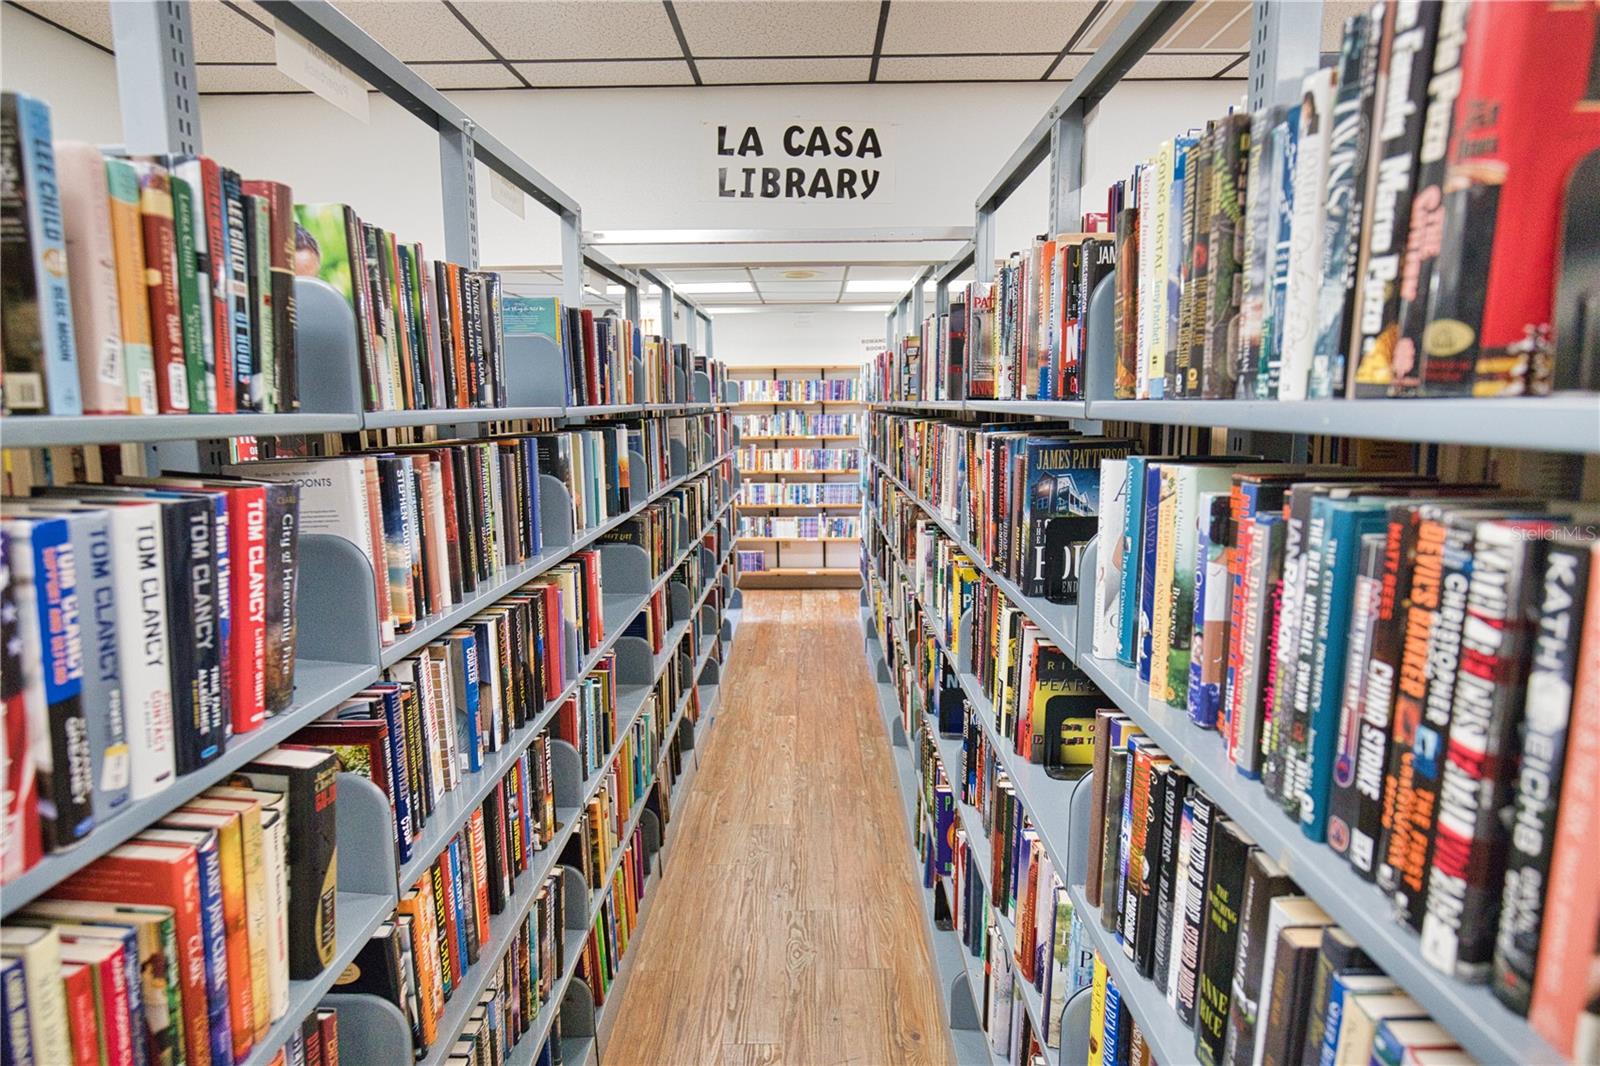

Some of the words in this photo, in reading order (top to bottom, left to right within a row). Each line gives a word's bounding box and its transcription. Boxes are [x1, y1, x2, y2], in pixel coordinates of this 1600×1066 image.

[33, 139, 56, 177] LEE
[717, 126, 764, 157] LA
[783, 125, 882, 158] CASA
[718, 167, 880, 200] LIBRARY
[1156, 151, 1168, 205] GOING
[1182, 155, 1199, 244] BRIMSTONE
[39, 180, 62, 242] CHILD
[227, 199, 243, 228] LEE
[230, 229, 246, 273] CHILD
[1153, 212, 1165, 272] POSTAL
[1361, 255, 1400, 336] Puzo
[1150, 304, 1163, 346] Pratchett
[1176, 328, 1190, 369] PRESTON
[1036, 450, 1071, 470] JAMES
[1125, 463, 1135, 502] AMANDA
[396, 469, 409, 521] STEPHEN
[189, 511, 210, 559] TOM
[215, 511, 230, 548] Tom
[247, 498, 264, 541] TOM
[280, 513, 295, 548] City
[1124, 504, 1133, 533] QUICK
[1146, 501, 1158, 555] AMANDA
[1286, 520, 1303, 562] IAN
[1307, 519, 1325, 546] THE
[57, 543, 75, 590] TOM
[89, 528, 112, 579] TOM
[136, 525, 157, 571] TOM
[402, 523, 412, 570] COONTS
[1247, 527, 1263, 568] RUN
[1326, 539, 1338, 567] THE
[1384, 522, 1404, 567] MATT
[1410, 521, 1447, 609] DEVIL'S
[217, 559, 231, 620] Clancy
[248, 546, 265, 623] CLANCY
[1303, 549, 1322, 587] REAL
[192, 564, 213, 649] CLANCY
[279, 569, 295, 642] Heavenly
[1118, 589, 1127, 639] COMPANION
[1193, 571, 1204, 613] QUINN
[1277, 561, 1300, 662] RANKIN
[1319, 568, 1337, 640] CELESTINE
[1379, 569, 1399, 620] REES
[63, 594, 84, 681] CLANCY
[94, 586, 119, 682] CLANCY
[141, 577, 164, 668] CLANCY
[1169, 586, 1181, 646] BLESSINGS
[1298, 594, 1317, 656] MICHAEL
[253, 627, 264, 656] LINE
[282, 646, 294, 675] Fire
[1240, 638, 1255, 680] RUN
[1398, 607, 1436, 699] BANKER
[1428, 573, 1468, 726] CHRISTOPHER
[424, 655, 435, 697] PATRICIA
[465, 647, 477, 684] COULTER
[1294, 661, 1311, 712] SWANN
[211, 695, 221, 728] FAITH
[254, 671, 265, 708] SIGHT
[1362, 659, 1394, 726] CHINA
[151, 690, 165, 753] CONTACT
[428, 698, 438, 743] CORNWELL
[544, 736, 552, 759] CLIVE
[1355, 724, 1387, 800] STRIKE
[545, 759, 553, 794] CUSSLER
[1163, 788, 1176, 827] SCOTT
[1193, 802, 1210, 819] THE
[512, 818, 521, 861] NAVIGATOR
[1160, 828, 1173, 862] REISS
[1189, 820, 1209, 870] VELOCITY
[205, 851, 221, 898] MARY
[432, 866, 447, 926] ROBERT
[456, 873, 464, 910] CRAIS
[1157, 879, 1170, 915] BLACK
[1189, 871, 1204, 884] OF
[447, 883, 456, 921] CRAIS
[1186, 884, 1203, 923] MONEY
[1243, 876, 1255, 932] AMERICA'S
[187, 934, 203, 988] CLARK
[211, 935, 228, 991] CLARK
[439, 940, 452, 985] CRAIS
[1154, 919, 1167, 965] MONDAY
[1183, 923, 1199, 960] STEPHEN
[1236, 932, 1249, 989] GAME
[1177, 962, 1196, 1009] RHODES
[1104, 992, 1118, 1034] KAREN
[1200, 997, 1222, 1039] RICE
